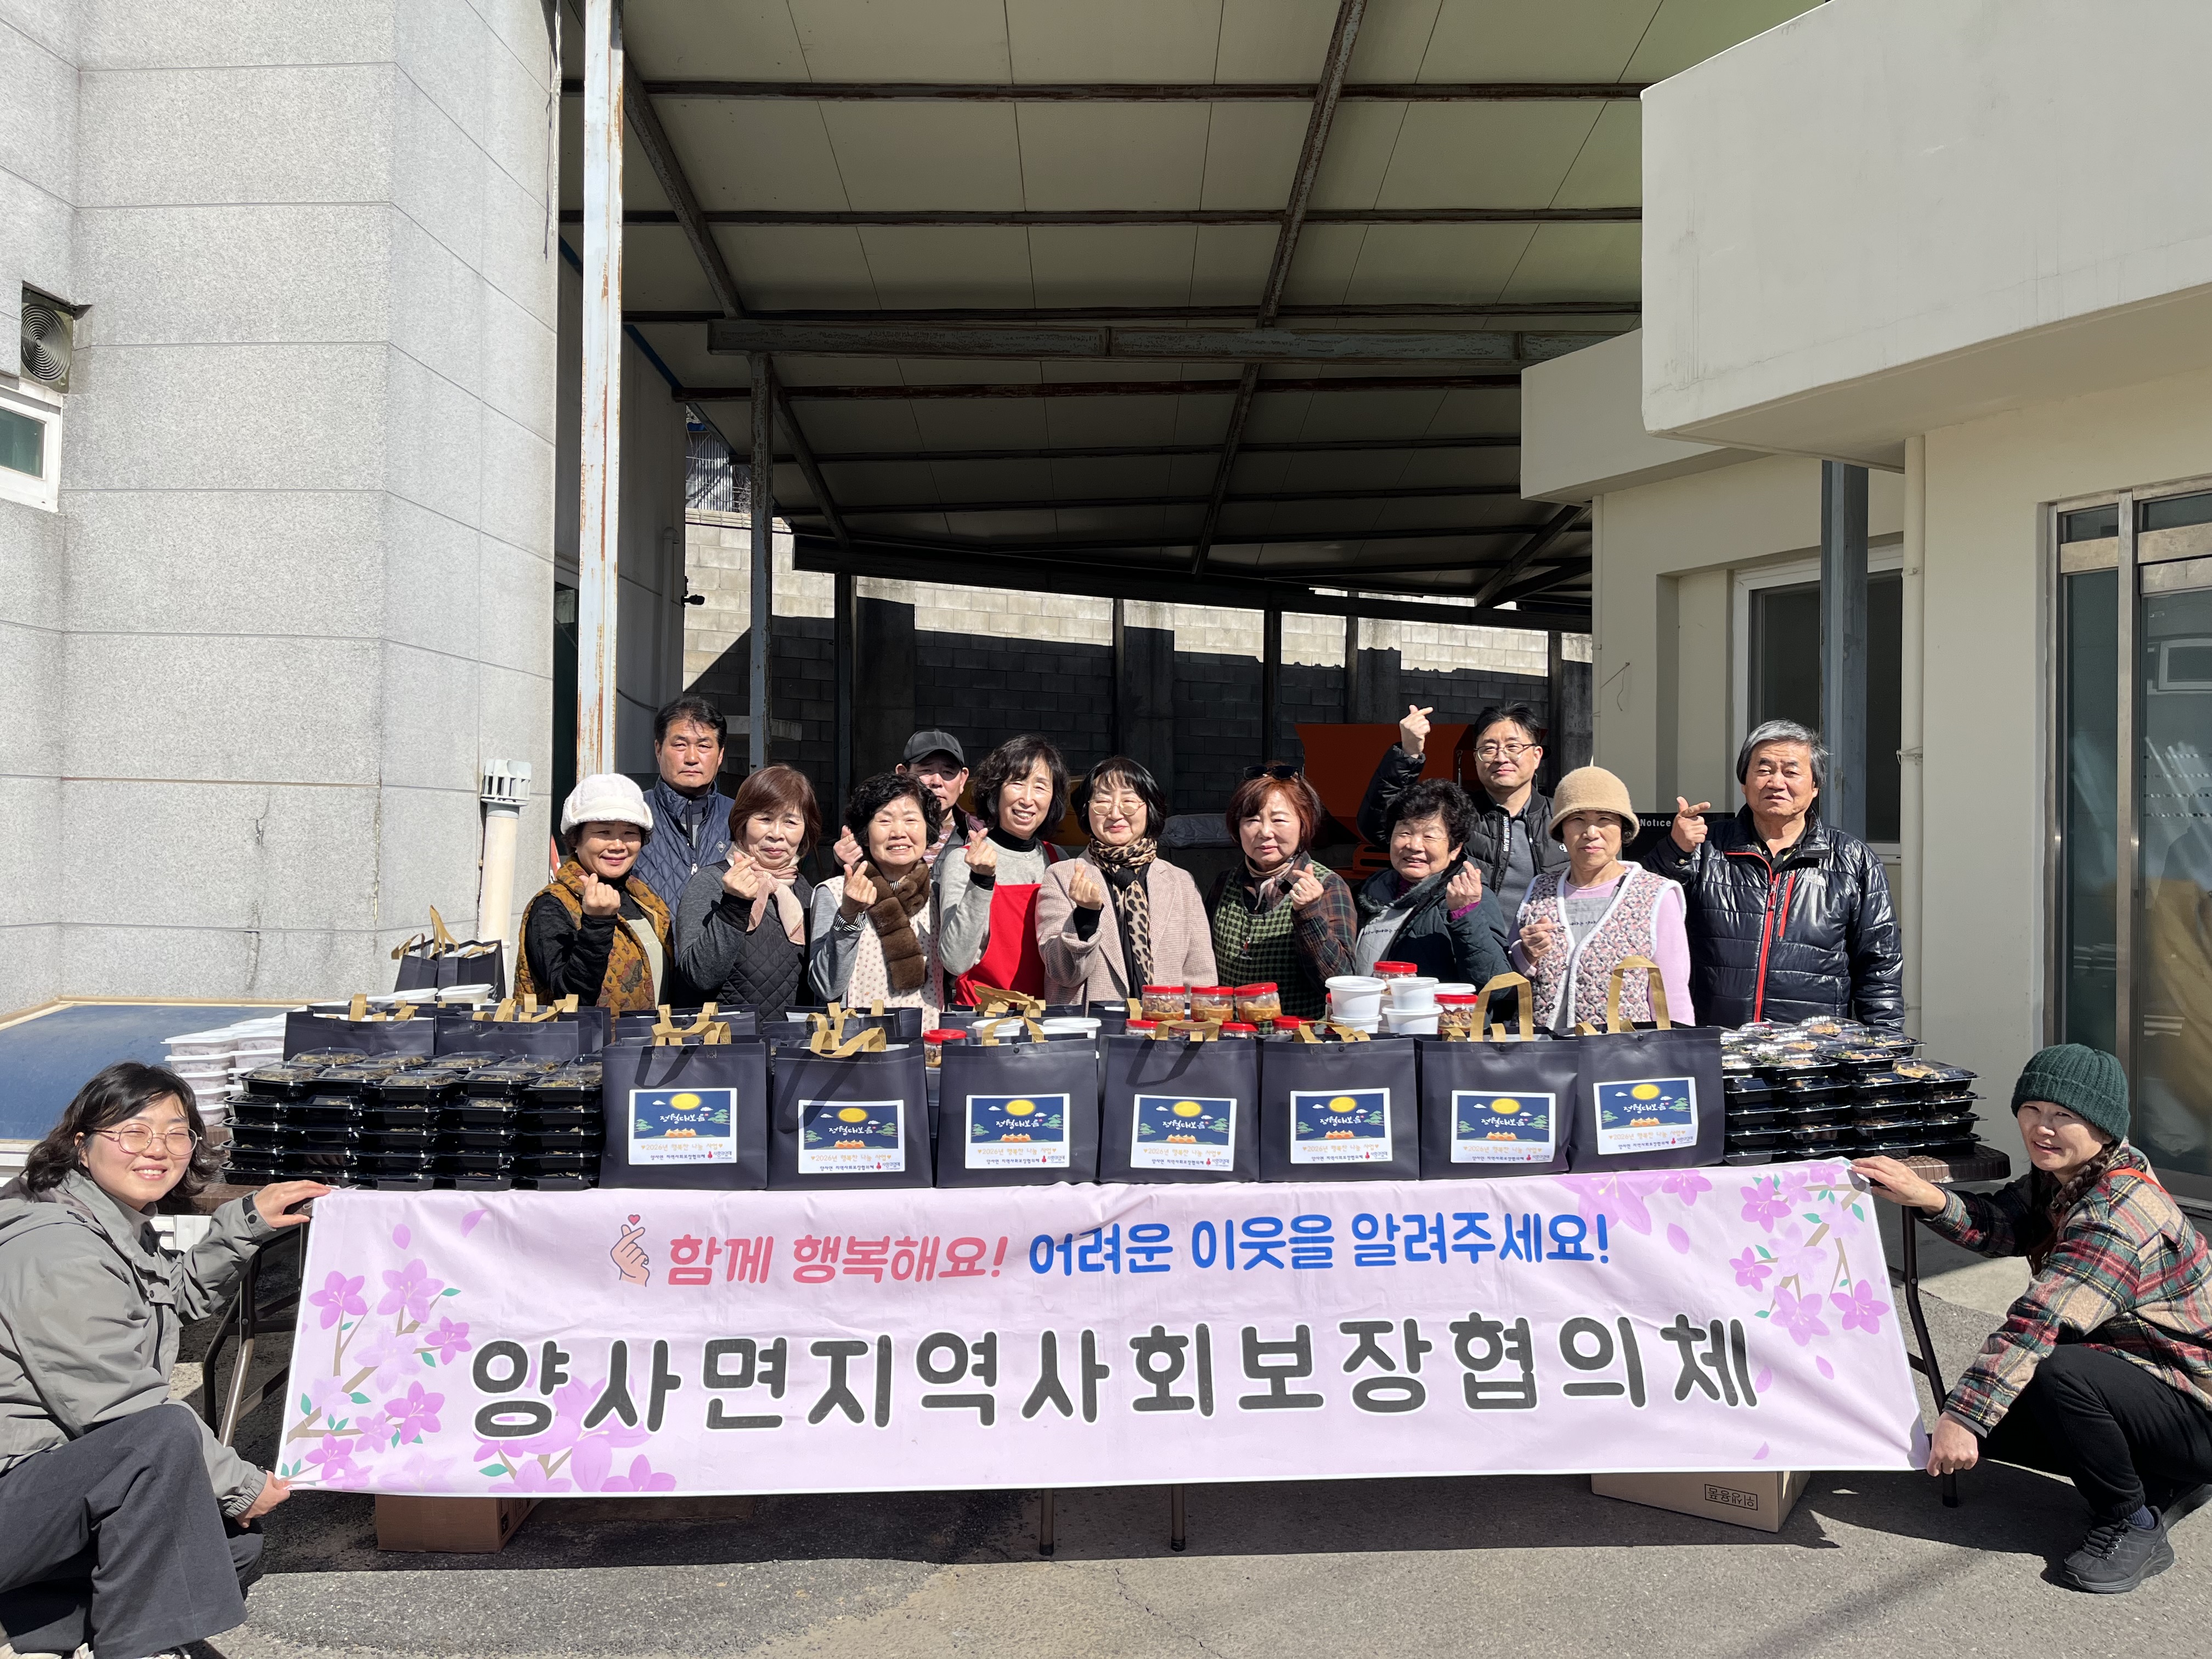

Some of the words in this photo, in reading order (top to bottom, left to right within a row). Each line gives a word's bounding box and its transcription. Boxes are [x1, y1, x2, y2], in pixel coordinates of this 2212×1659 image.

[1640, 819, 1672, 827] Notice
[1623, 1103, 1666, 1114] 정월대보름
[660, 1114, 706, 1124] 정월대보름
[996, 1119, 1039, 1129] 정월대보름
[1320, 1116, 1361, 1126] 정월대보름
[1481, 1117, 1525, 1127] 정월대보름
[1163, 1119, 1205, 1130] 정월대보름
[828, 1126, 873, 1136] 정월대보름
[668, 1234, 774, 1285] 함께
[793, 1234, 1008, 1284] 행복해요!
[1030, 1223, 1173, 1276] 어려운
[1192, 1215, 1335, 1270] 이웃을
[1352, 1212, 1609, 1267] 알려주세요!
[473, 1312, 1757, 1437] 양사면지역사회보장협의체
[1707, 1487, 1755, 1507] 위생용품
